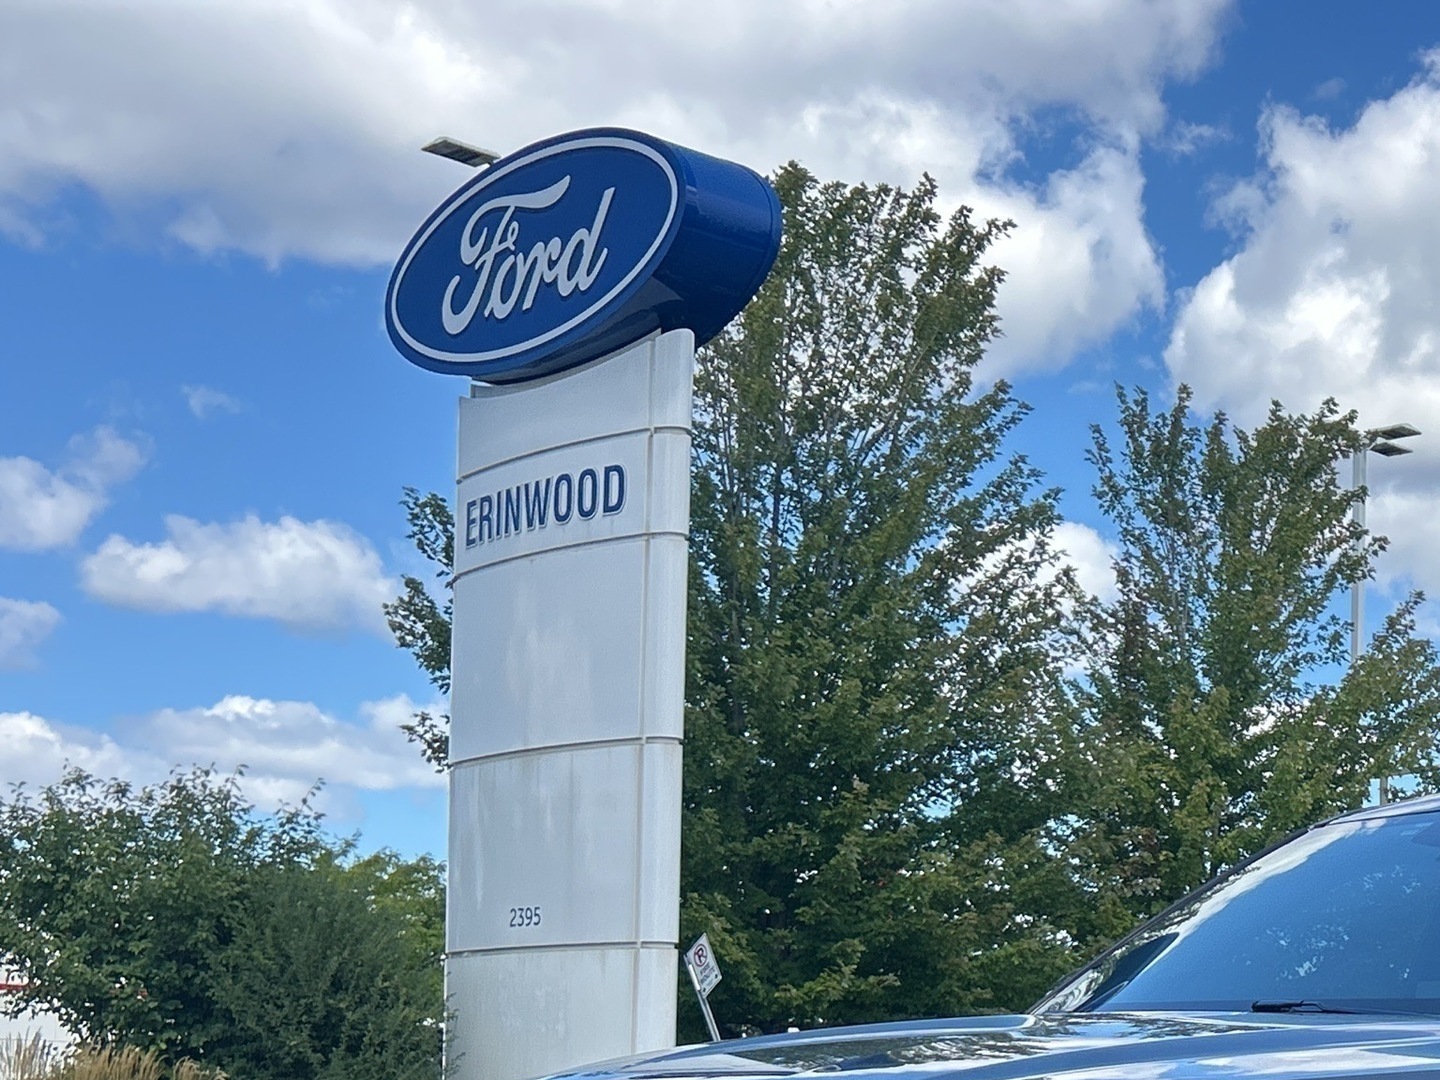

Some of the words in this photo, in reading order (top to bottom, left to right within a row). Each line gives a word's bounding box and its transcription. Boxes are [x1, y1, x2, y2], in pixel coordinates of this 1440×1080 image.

[442, 175, 616, 335] Ford
[466, 464, 626, 549] ERINWOOD
[509, 906, 542, 928] 2395
